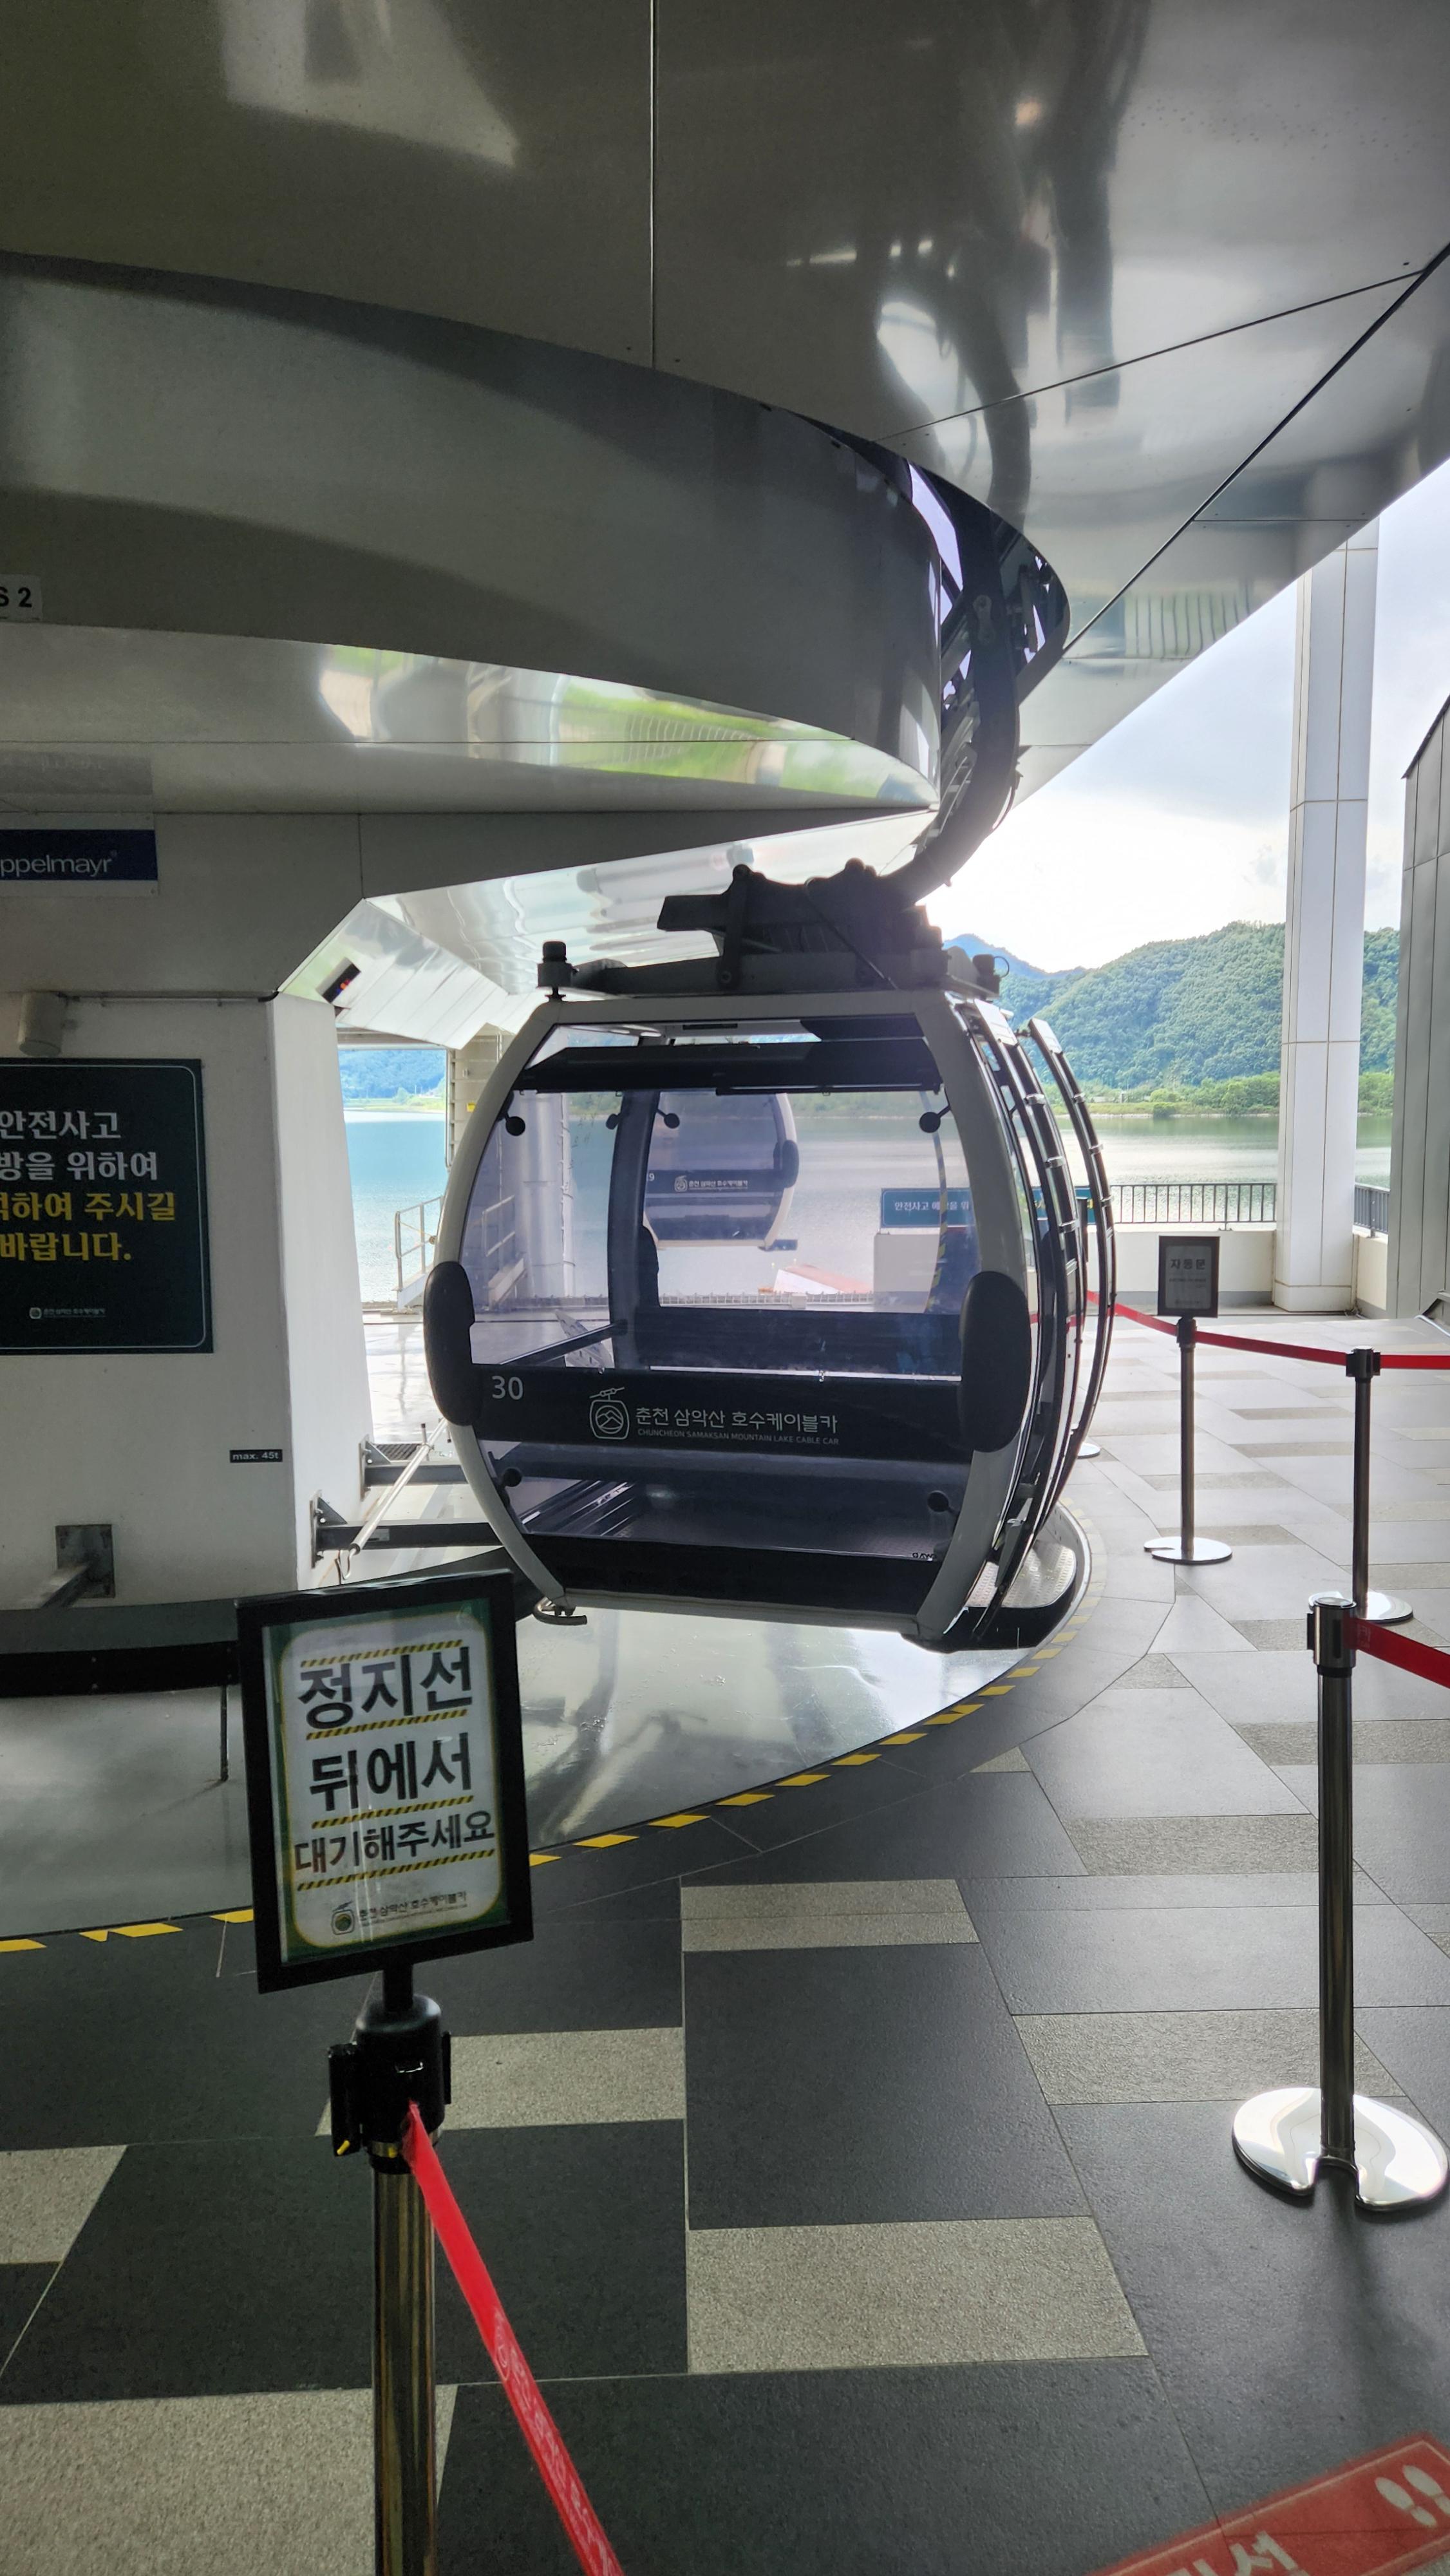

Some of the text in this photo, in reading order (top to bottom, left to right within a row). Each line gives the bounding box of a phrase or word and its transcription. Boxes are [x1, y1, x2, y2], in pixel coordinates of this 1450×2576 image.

[17, 587, 33, 608] 2
[0, 855, 112, 877] ppelmayr
[0, 1110, 122, 1140] 안전사고
[0, 1151, 158, 1181] 방을 위하여
[646, 1173, 655, 1182] 9
[84, 1192, 176, 1221] 주시길
[894, 1201, 929, 1211] 안전사고
[932, 1201, 957, 1211] 예을
[0, 1232, 132, 1261] 바랍니다.
[491, 1376, 524, 1401] 30
[635, 1406, 838, 1434] 춘천 삼악산 호수케이블카
[637, 1428, 685, 1437] CHUNCHEON
[686, 1431, 729, 1439] SAMAKSAN
[731, 1433, 772, 1442] MOUNTAIN
[774, 1435, 793, 1443] LAKE
[796, 1436, 821, 1444] CABLE
[298, 1646, 473, 1730] 정지선
[309, 1732, 472, 1812] 뒤에서
[295, 1810, 494, 1874] 대기해주세요
